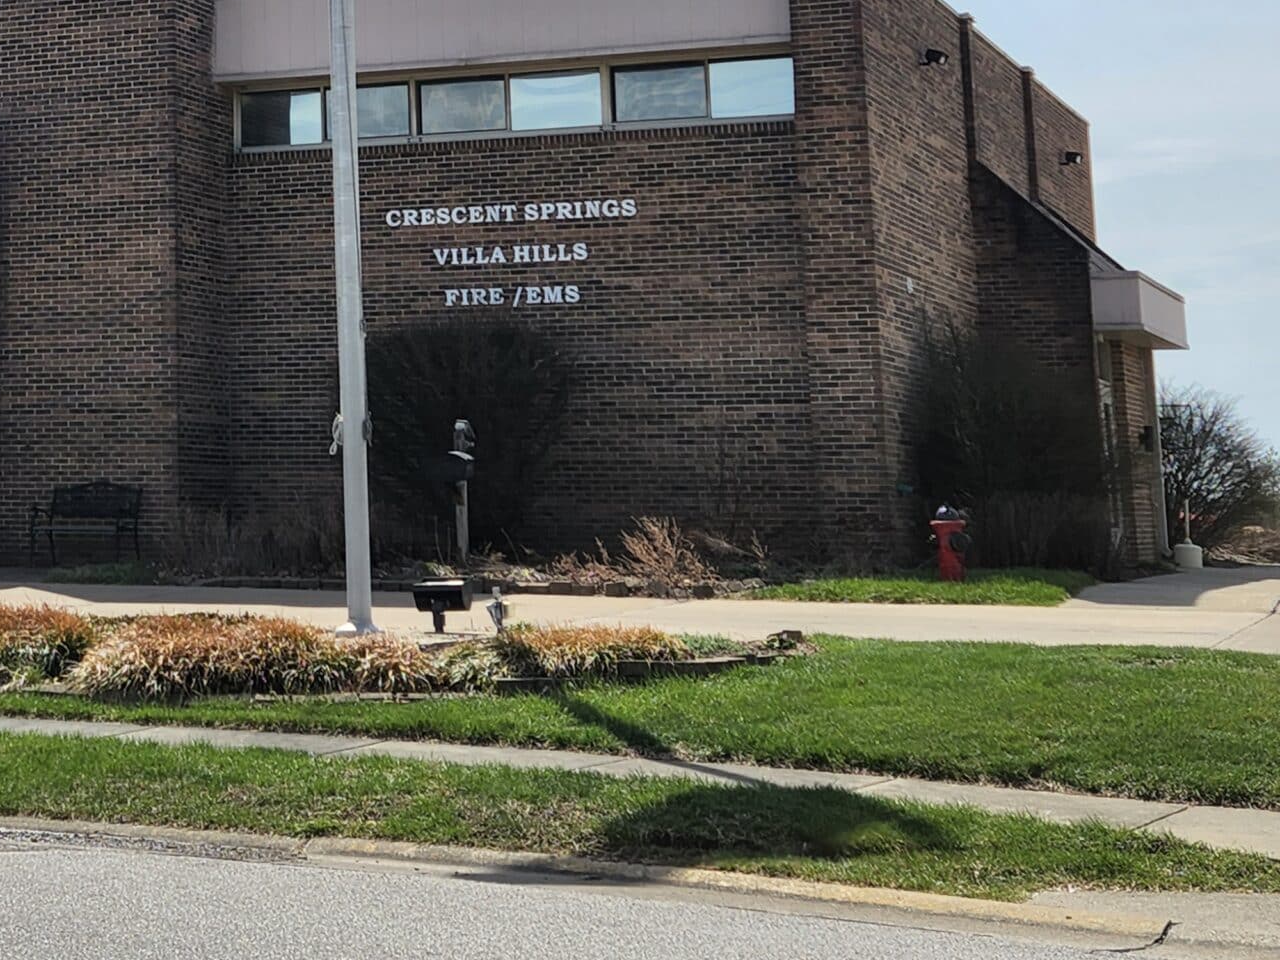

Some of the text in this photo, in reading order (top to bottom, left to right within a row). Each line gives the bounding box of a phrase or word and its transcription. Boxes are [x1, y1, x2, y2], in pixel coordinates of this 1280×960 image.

[385, 199, 638, 228] CRESCENT SPRINGS
[433, 243, 589, 266] VILLA HILLS
[444, 287, 505, 307] FIRE
